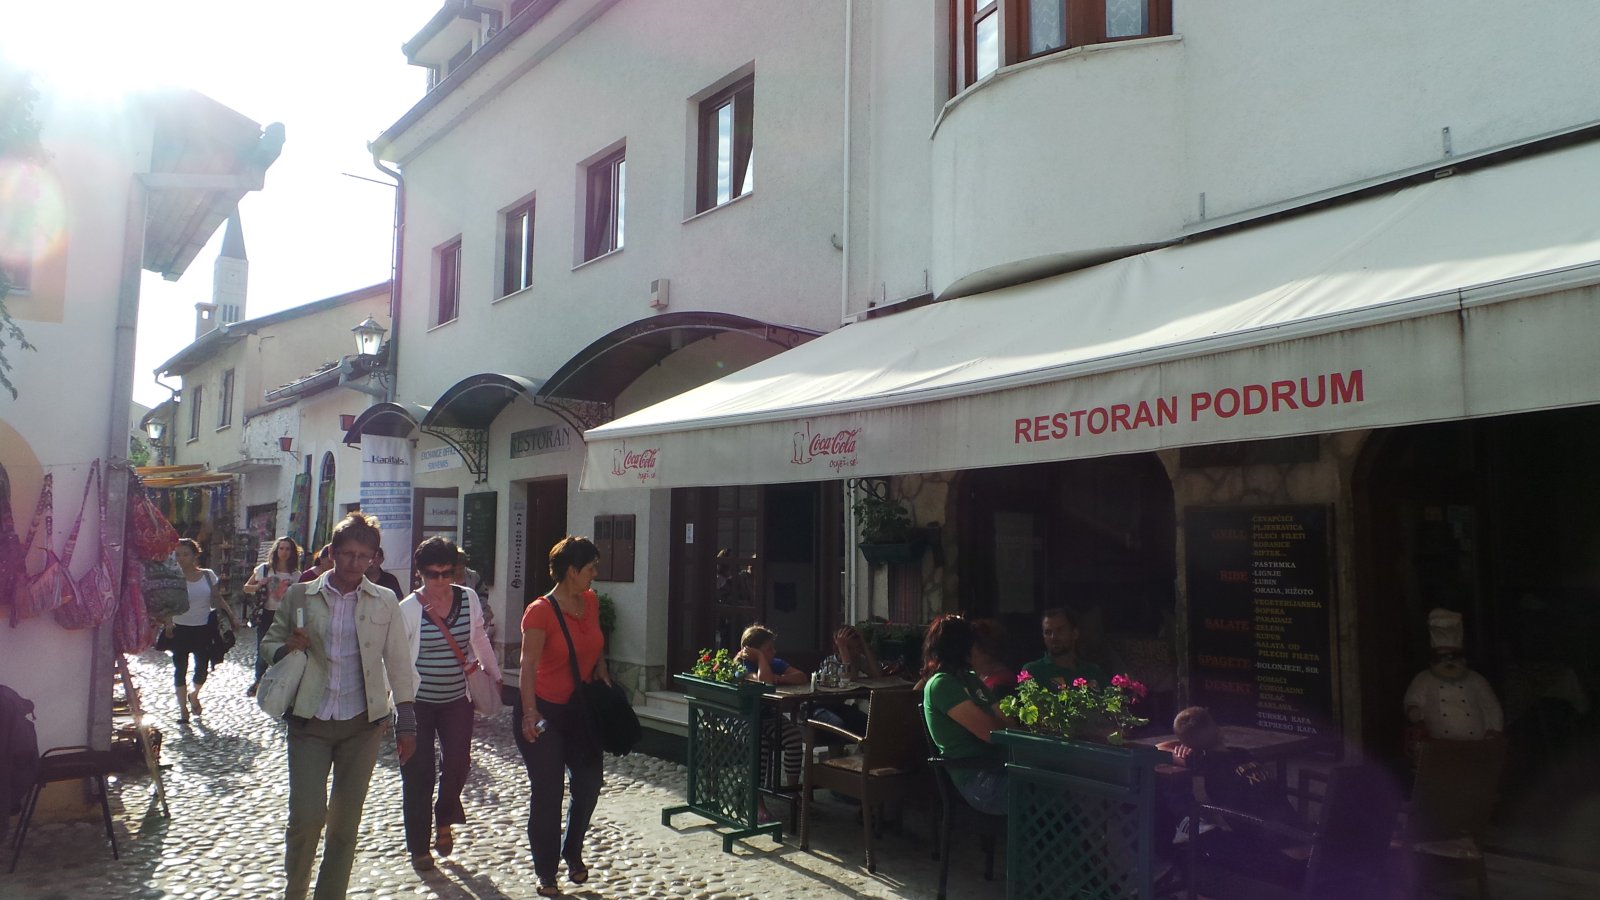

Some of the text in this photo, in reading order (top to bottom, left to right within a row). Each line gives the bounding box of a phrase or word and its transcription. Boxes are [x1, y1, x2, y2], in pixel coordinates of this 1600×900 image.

[1014, 369, 1364, 444] RESTORAN PODRUM
[809, 428, 862, 456] Coca-Cola
